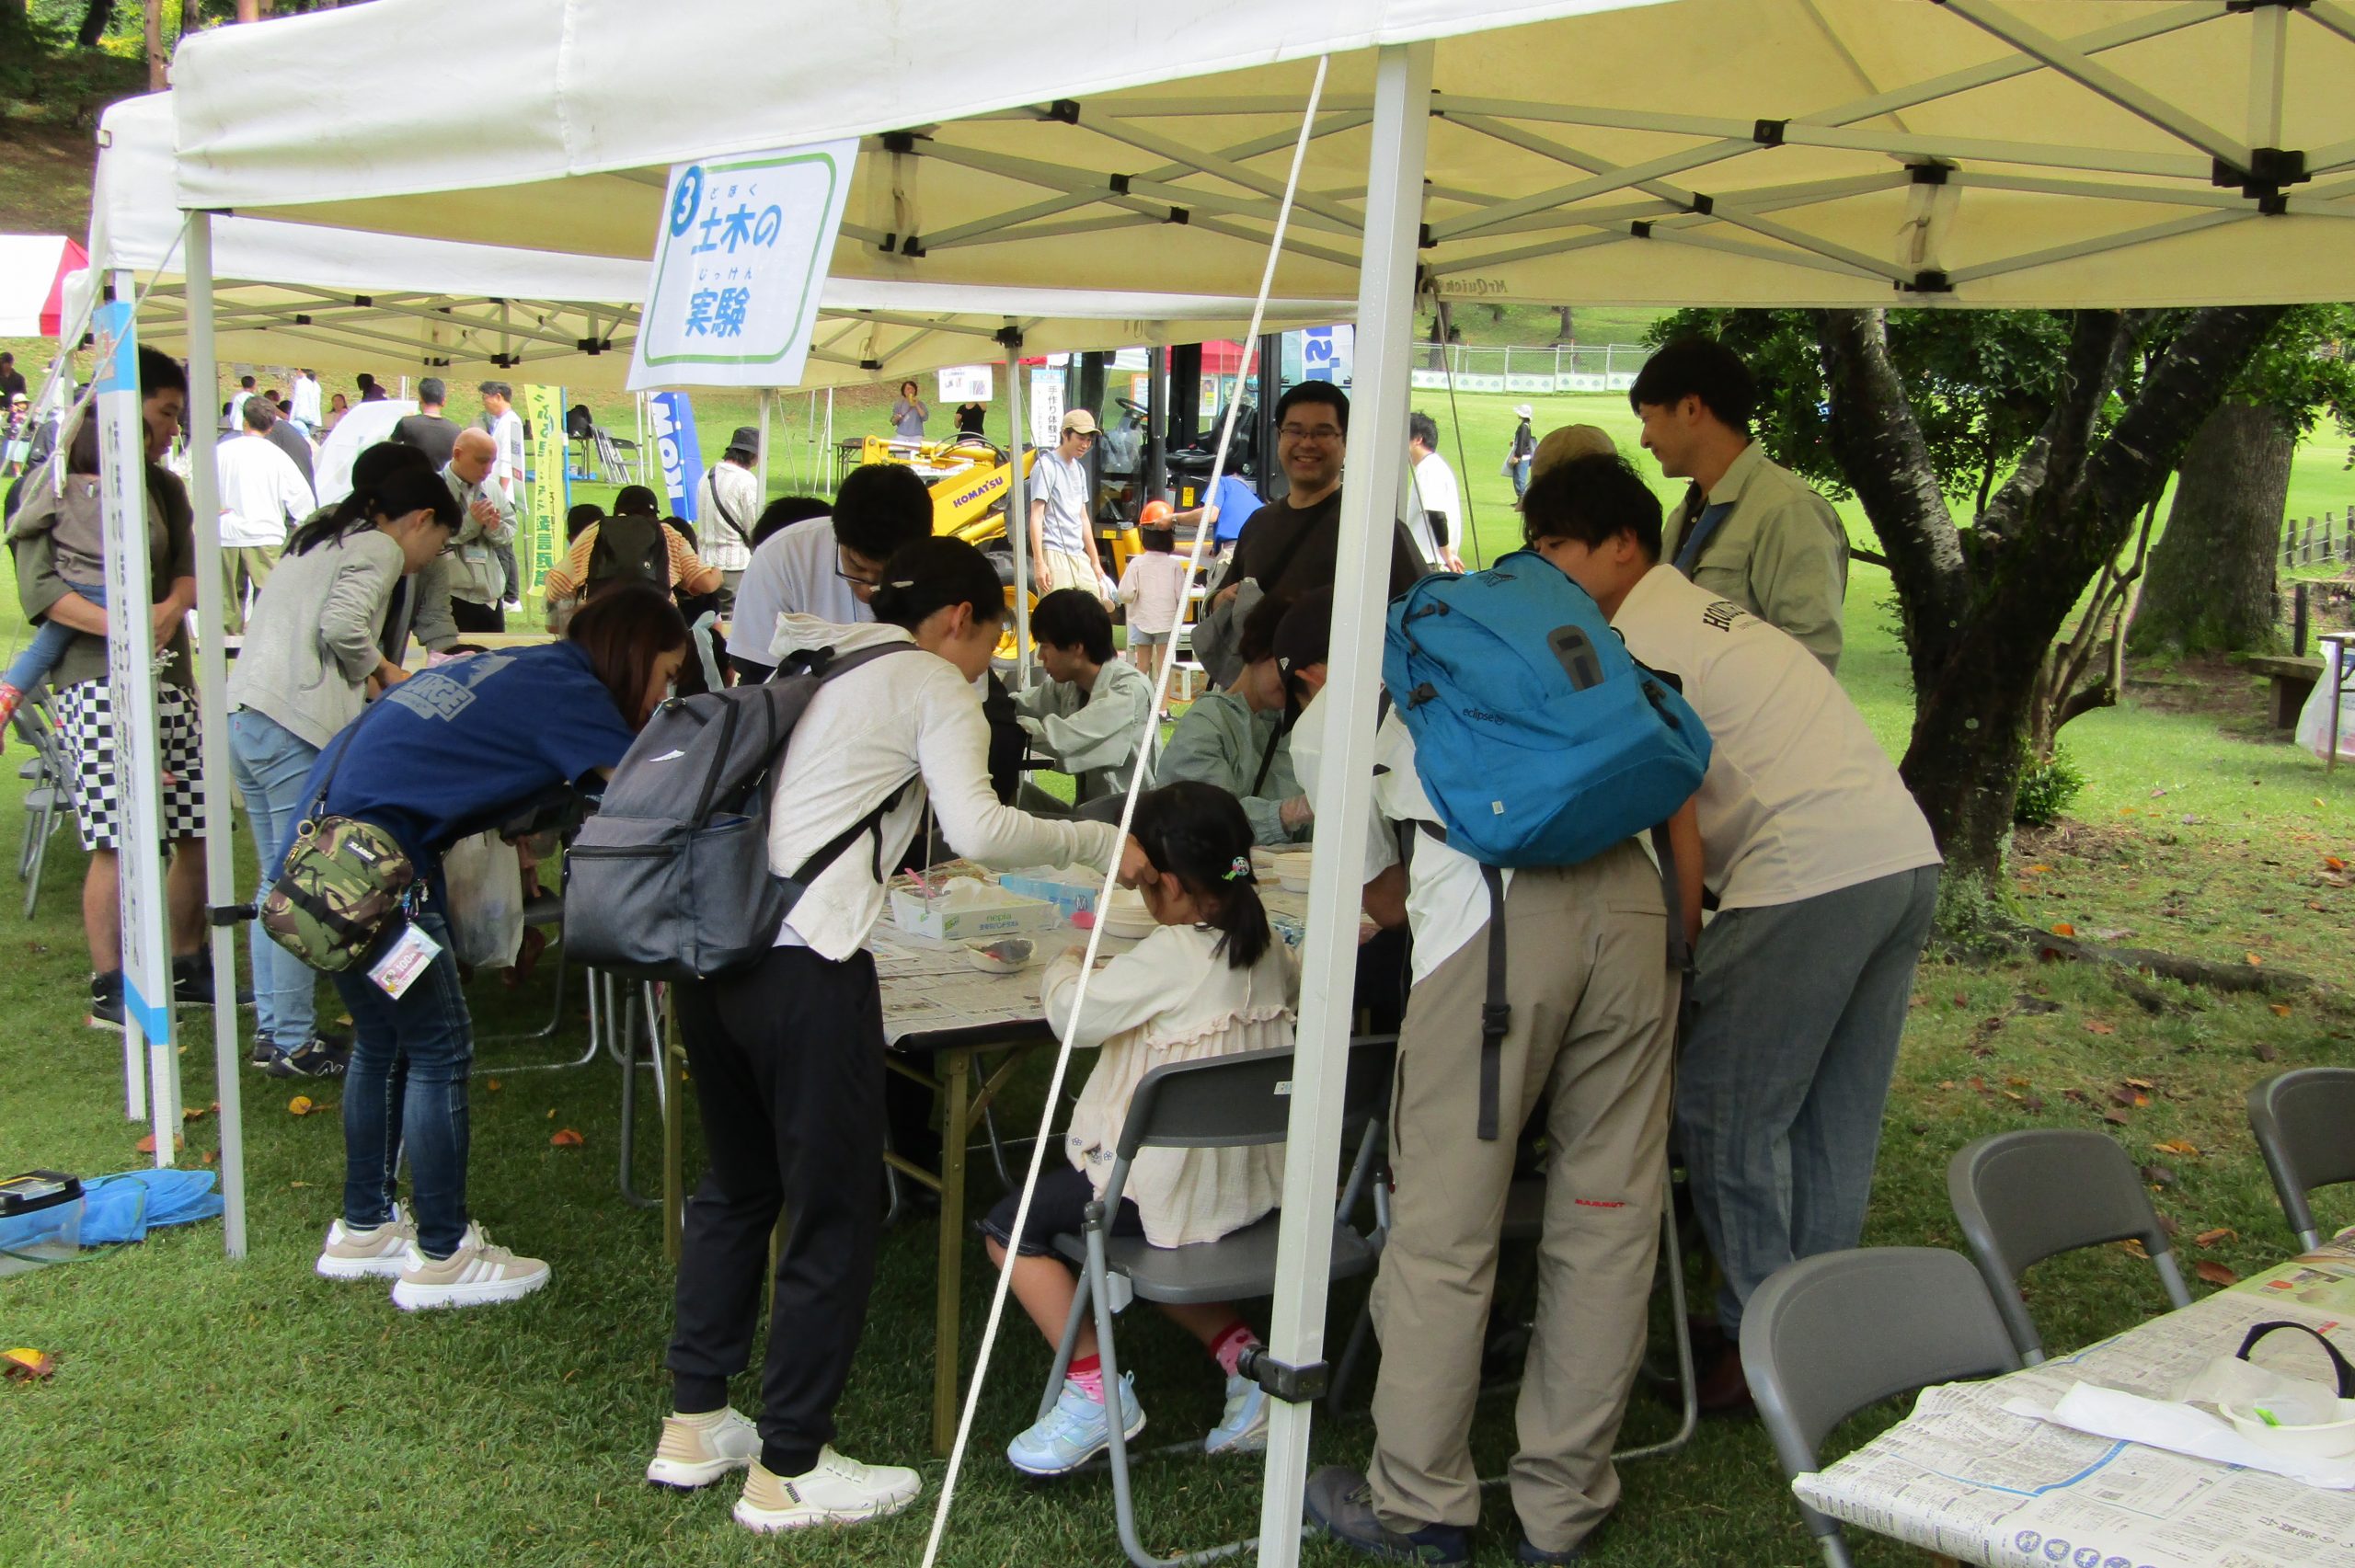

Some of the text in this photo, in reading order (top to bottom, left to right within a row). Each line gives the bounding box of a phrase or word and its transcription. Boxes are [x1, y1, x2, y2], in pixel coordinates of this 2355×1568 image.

[709, 184, 758, 200] どぼく
[691, 203, 782, 255] 土木の
[698, 267, 752, 281] じっけん
[684, 287, 752, 338] 実験
[953, 476, 1004, 508] KOMATSU
